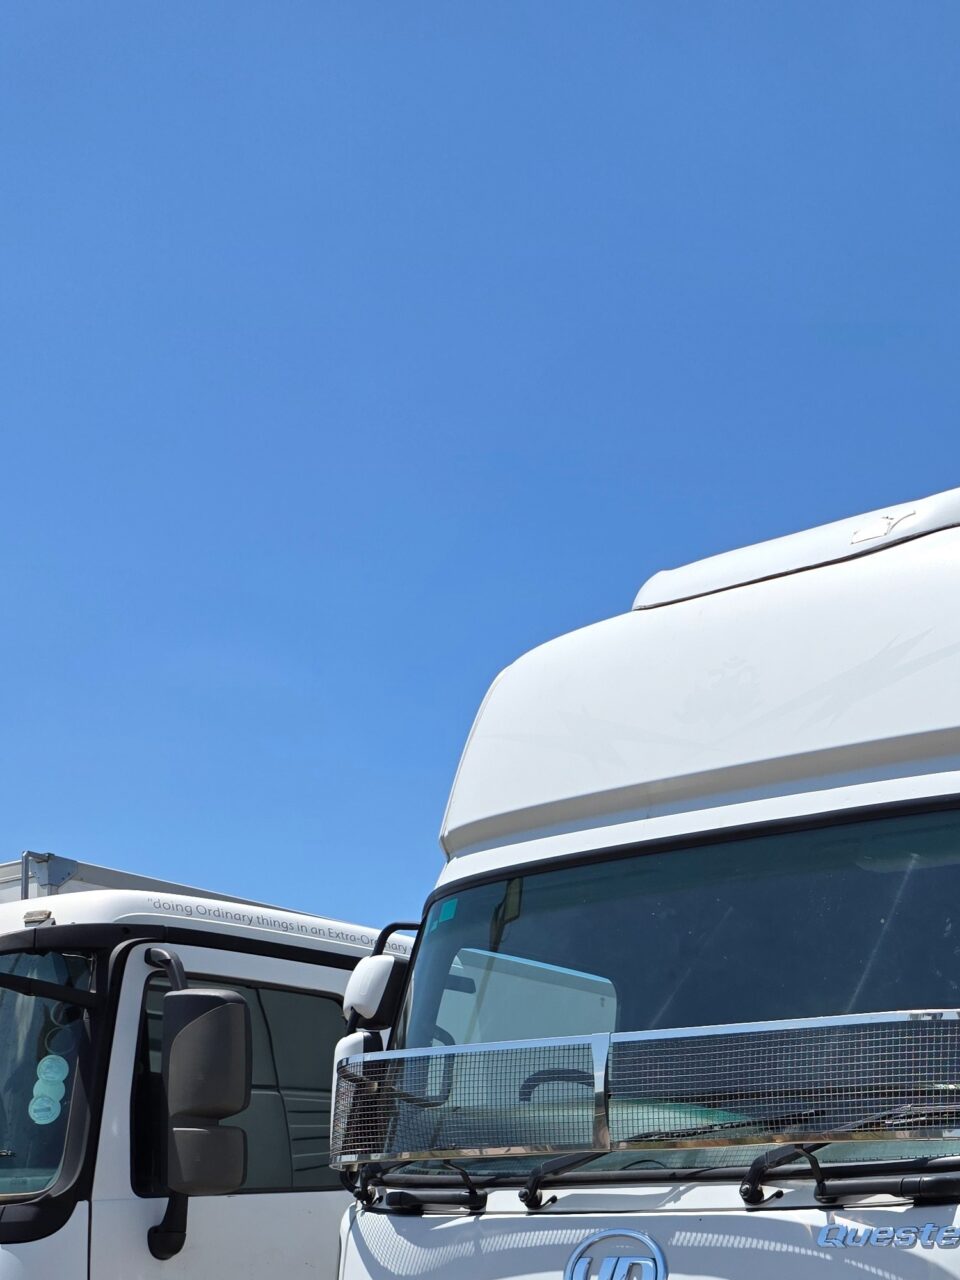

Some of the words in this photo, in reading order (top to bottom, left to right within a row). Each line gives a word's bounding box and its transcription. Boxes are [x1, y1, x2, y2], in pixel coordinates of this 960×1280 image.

[195, 903, 254, 926] Ordinary
[255, 914, 295, 932] things
[296, 920, 308, 933] in
[310, 926, 326, 937] an
[328, 927, 408, 954] Extra-Ornary
